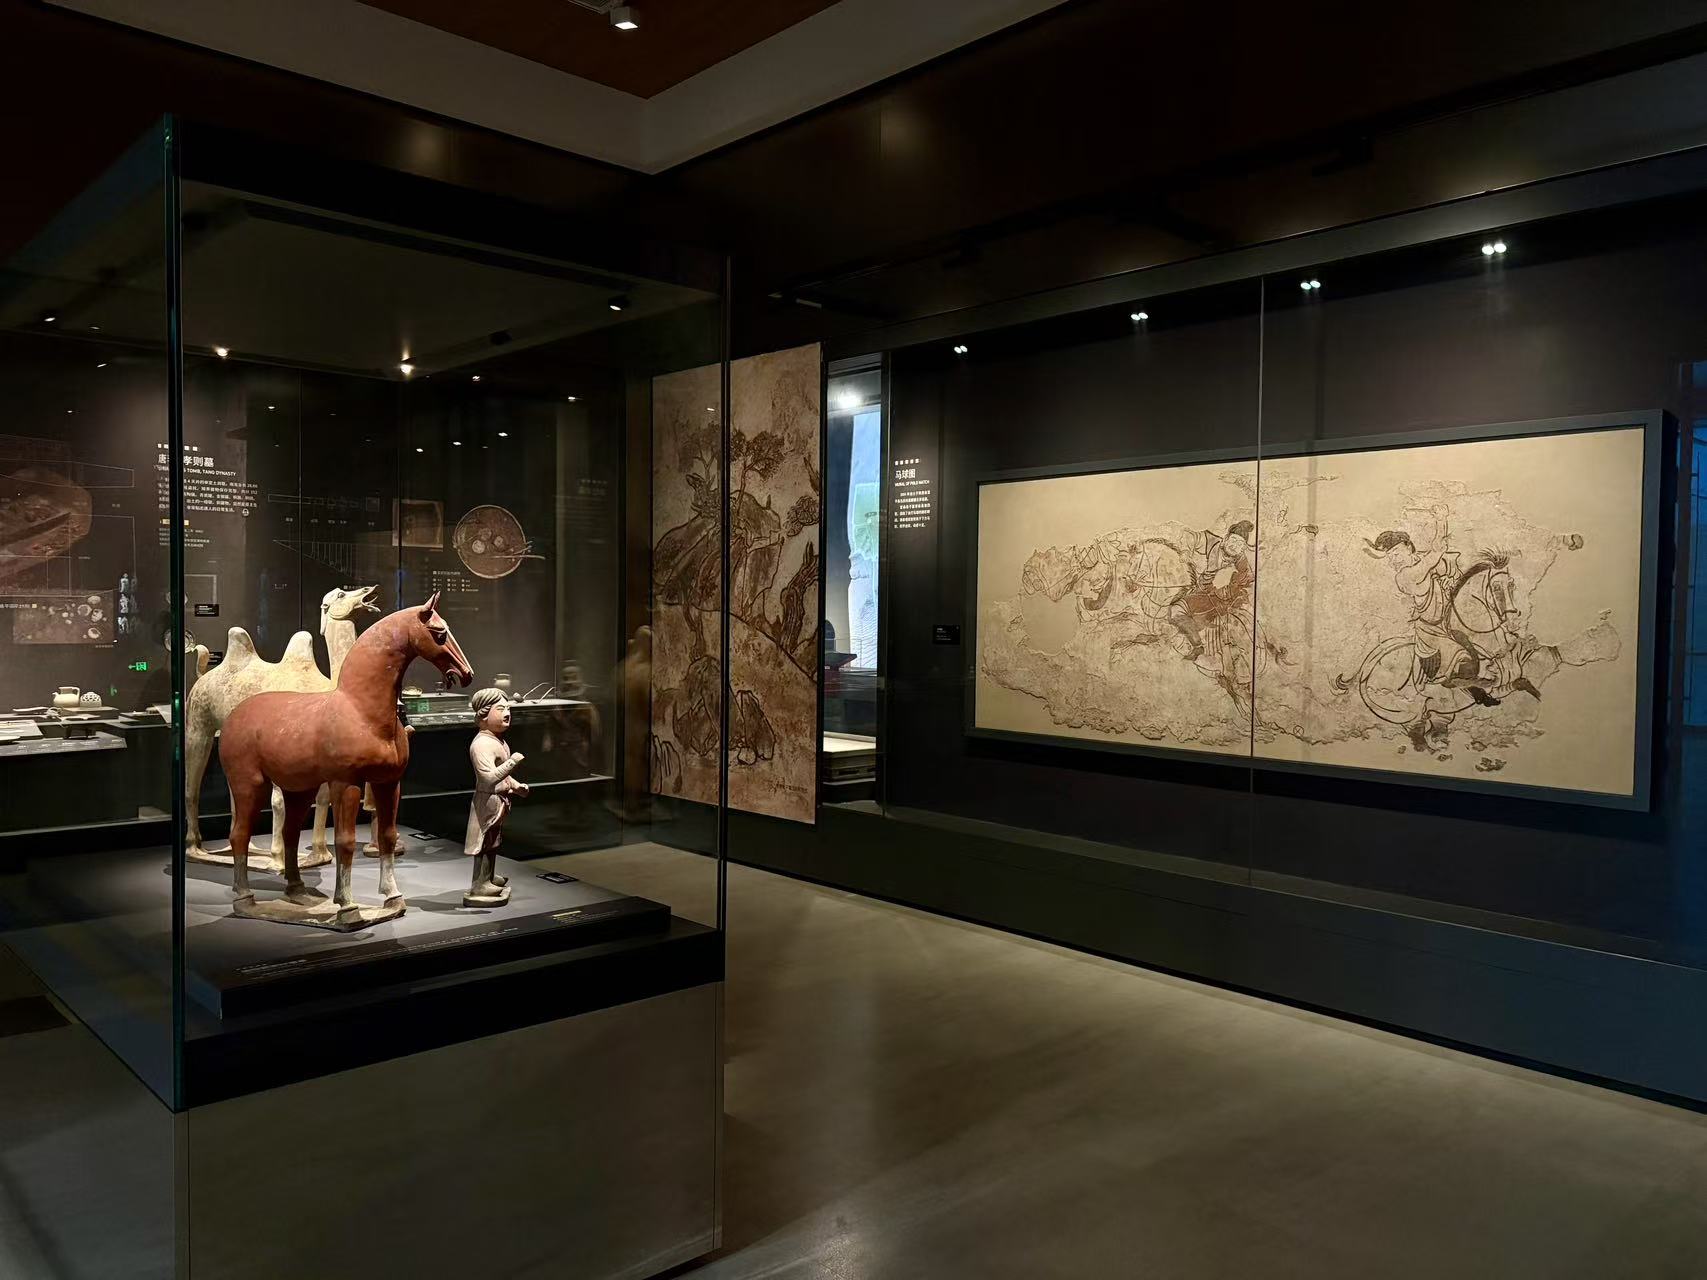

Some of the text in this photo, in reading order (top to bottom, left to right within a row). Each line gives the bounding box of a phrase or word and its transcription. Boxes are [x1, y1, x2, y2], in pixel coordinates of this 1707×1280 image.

[158, 453, 214, 468] 唐孝则墓
[895, 469, 916, 479] 马球图
